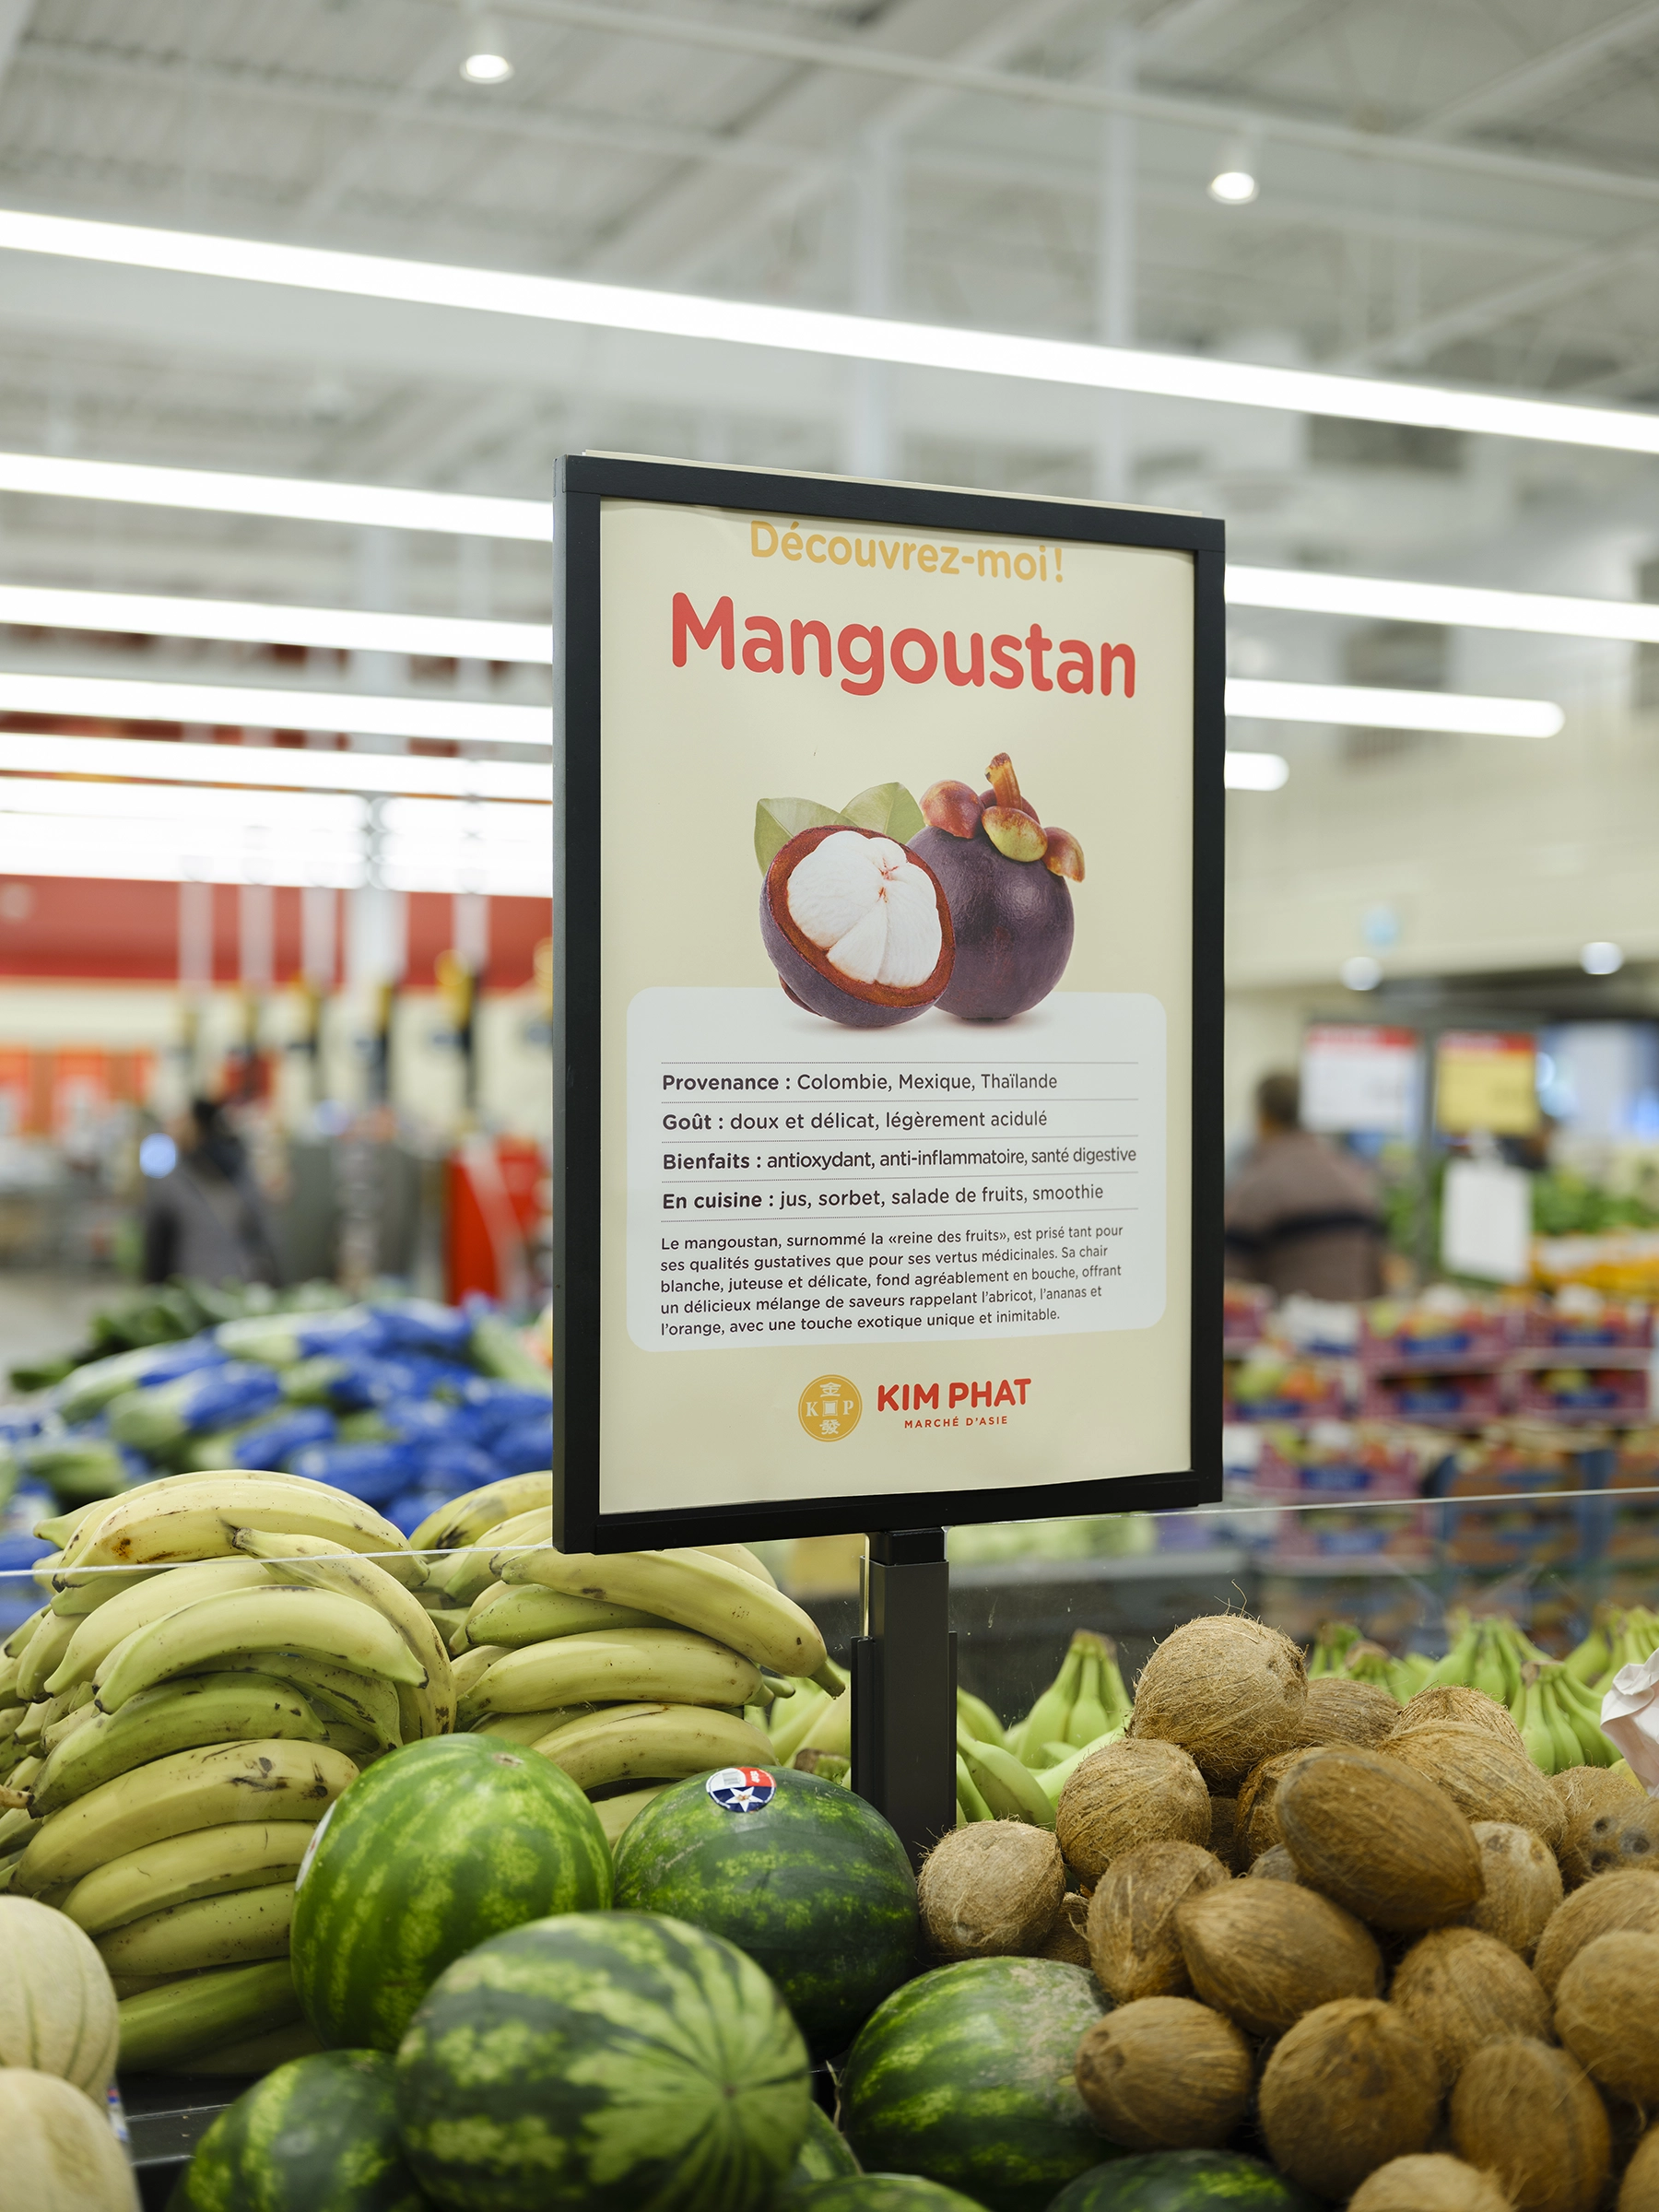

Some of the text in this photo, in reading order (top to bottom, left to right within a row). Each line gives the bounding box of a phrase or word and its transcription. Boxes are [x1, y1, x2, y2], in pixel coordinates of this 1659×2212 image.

[672, 592, 1136, 698] Mangoustan
[663, 1074, 780, 1091] Provenance
[796, 1073, 892, 1093] Colombie,
[899, 1073, 976, 1092] Mexique,
[980, 1073, 1058, 1089] Thaïlande
[662, 1112, 712, 1131] Goût
[729, 1112, 779, 1130] doux
[784, 1113, 805, 1130] et
[810, 1112, 880, 1132] délicat,
[886, 1111, 986, 1131] légèrement
[990, 1110, 1048, 1127] acidulé
[663, 1152, 750, 1171] Bienfaits
[766, 1150, 876, 1171] antioxydant,
[879, 1147, 1028, 1167] anti-inflammatoire,
[1030, 1147, 1070, 1164] santé
[1072, 1146, 1136, 1166] digestive
[663, 1193, 688, 1210] En
[693, 1191, 763, 1209] cuisine
[779, 1190, 812, 1210] jus,
[818, 1189, 886, 1208] sorbet,
[891, 1187, 950, 1206] salade
[955, 1186, 977, 1204] de
[982, 1185, 1028, 1205] fruits,
[1032, 1183, 1103, 1201] smoothie
[661, 1225, 1124, 1252] Le mangoustan, surnommé la «reine des fruits», est prisé tant pour
[660, 1244, 1109, 1274] ses qualités gustatives que pour ses vertus médicinales. Sa chair
[661, 1265, 1122, 1293] blanche, juteuse et délicate, fond agréablement en bouche, offrant
[661, 1286, 1102, 1315] un délicieux mélange de saveurs rappelant l’abricot, l’ananas et
[661, 1307, 1060, 1337] l’orange, avec une touche exotique unique et inimitable.
[877, 1378, 1032, 1413] KIM PHAT
[904, 1415, 1008, 1429] MARCHÉ D’ASIE
